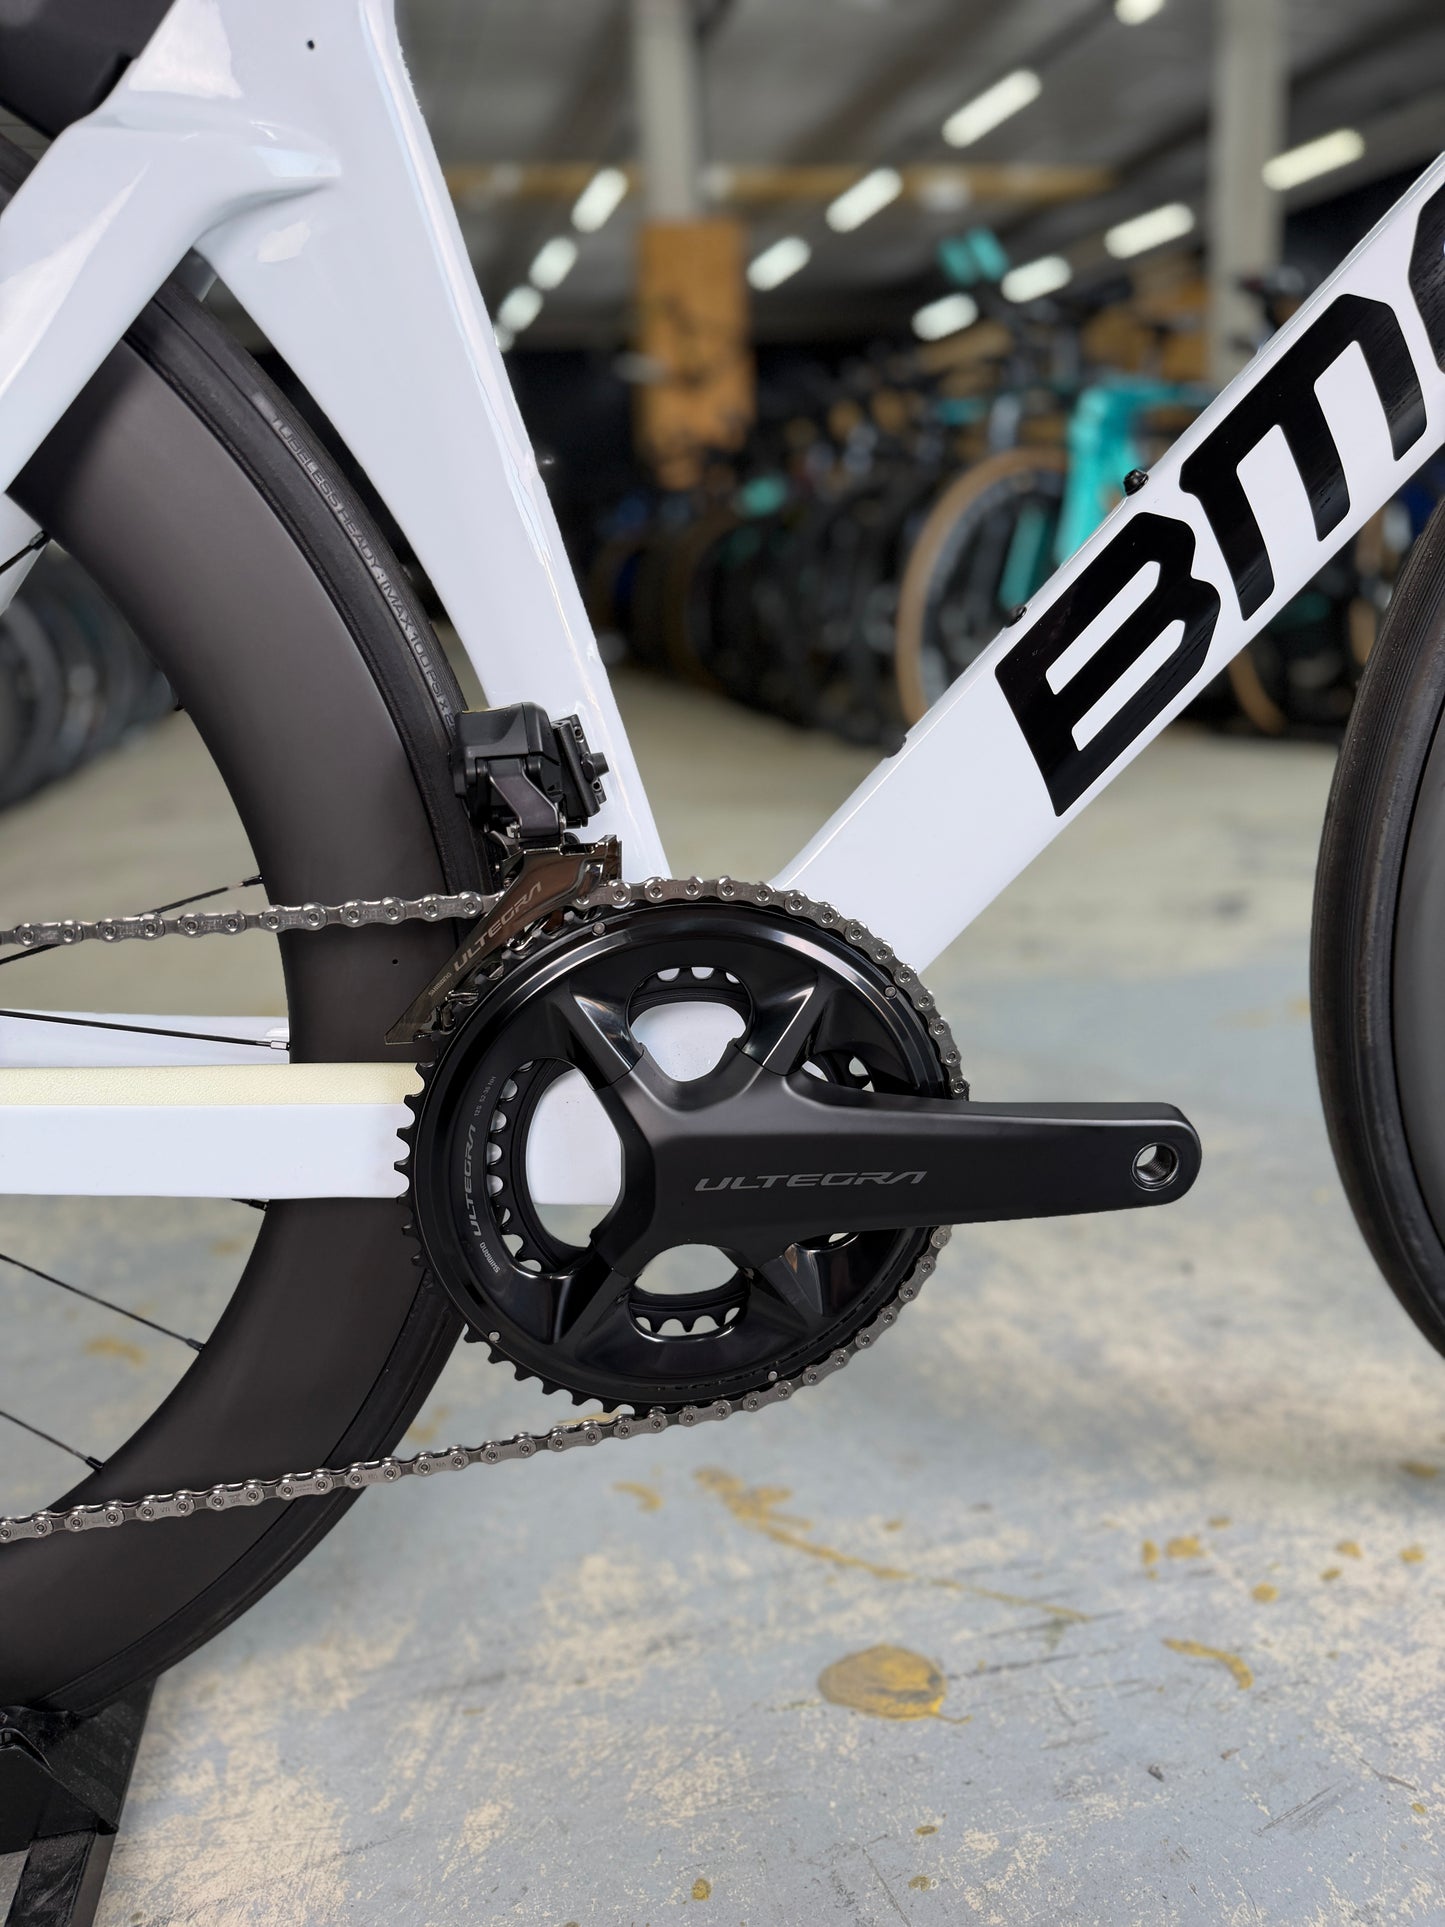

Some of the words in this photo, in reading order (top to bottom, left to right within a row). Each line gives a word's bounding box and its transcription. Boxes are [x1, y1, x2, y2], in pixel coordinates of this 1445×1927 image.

[272, 416, 338, 507] TUBELESS
[337, 507, 382, 568] READY
[411, 632, 431, 667] 100
[995, 181, 1445, 817] BM
[453, 881, 542, 971] ULTEGRA
[464, 1124, 482, 1237] ULTEGRA
[694, 1171, 928, 1192] ULTEGRA
[480, 1241, 501, 1274] SHIMANO
